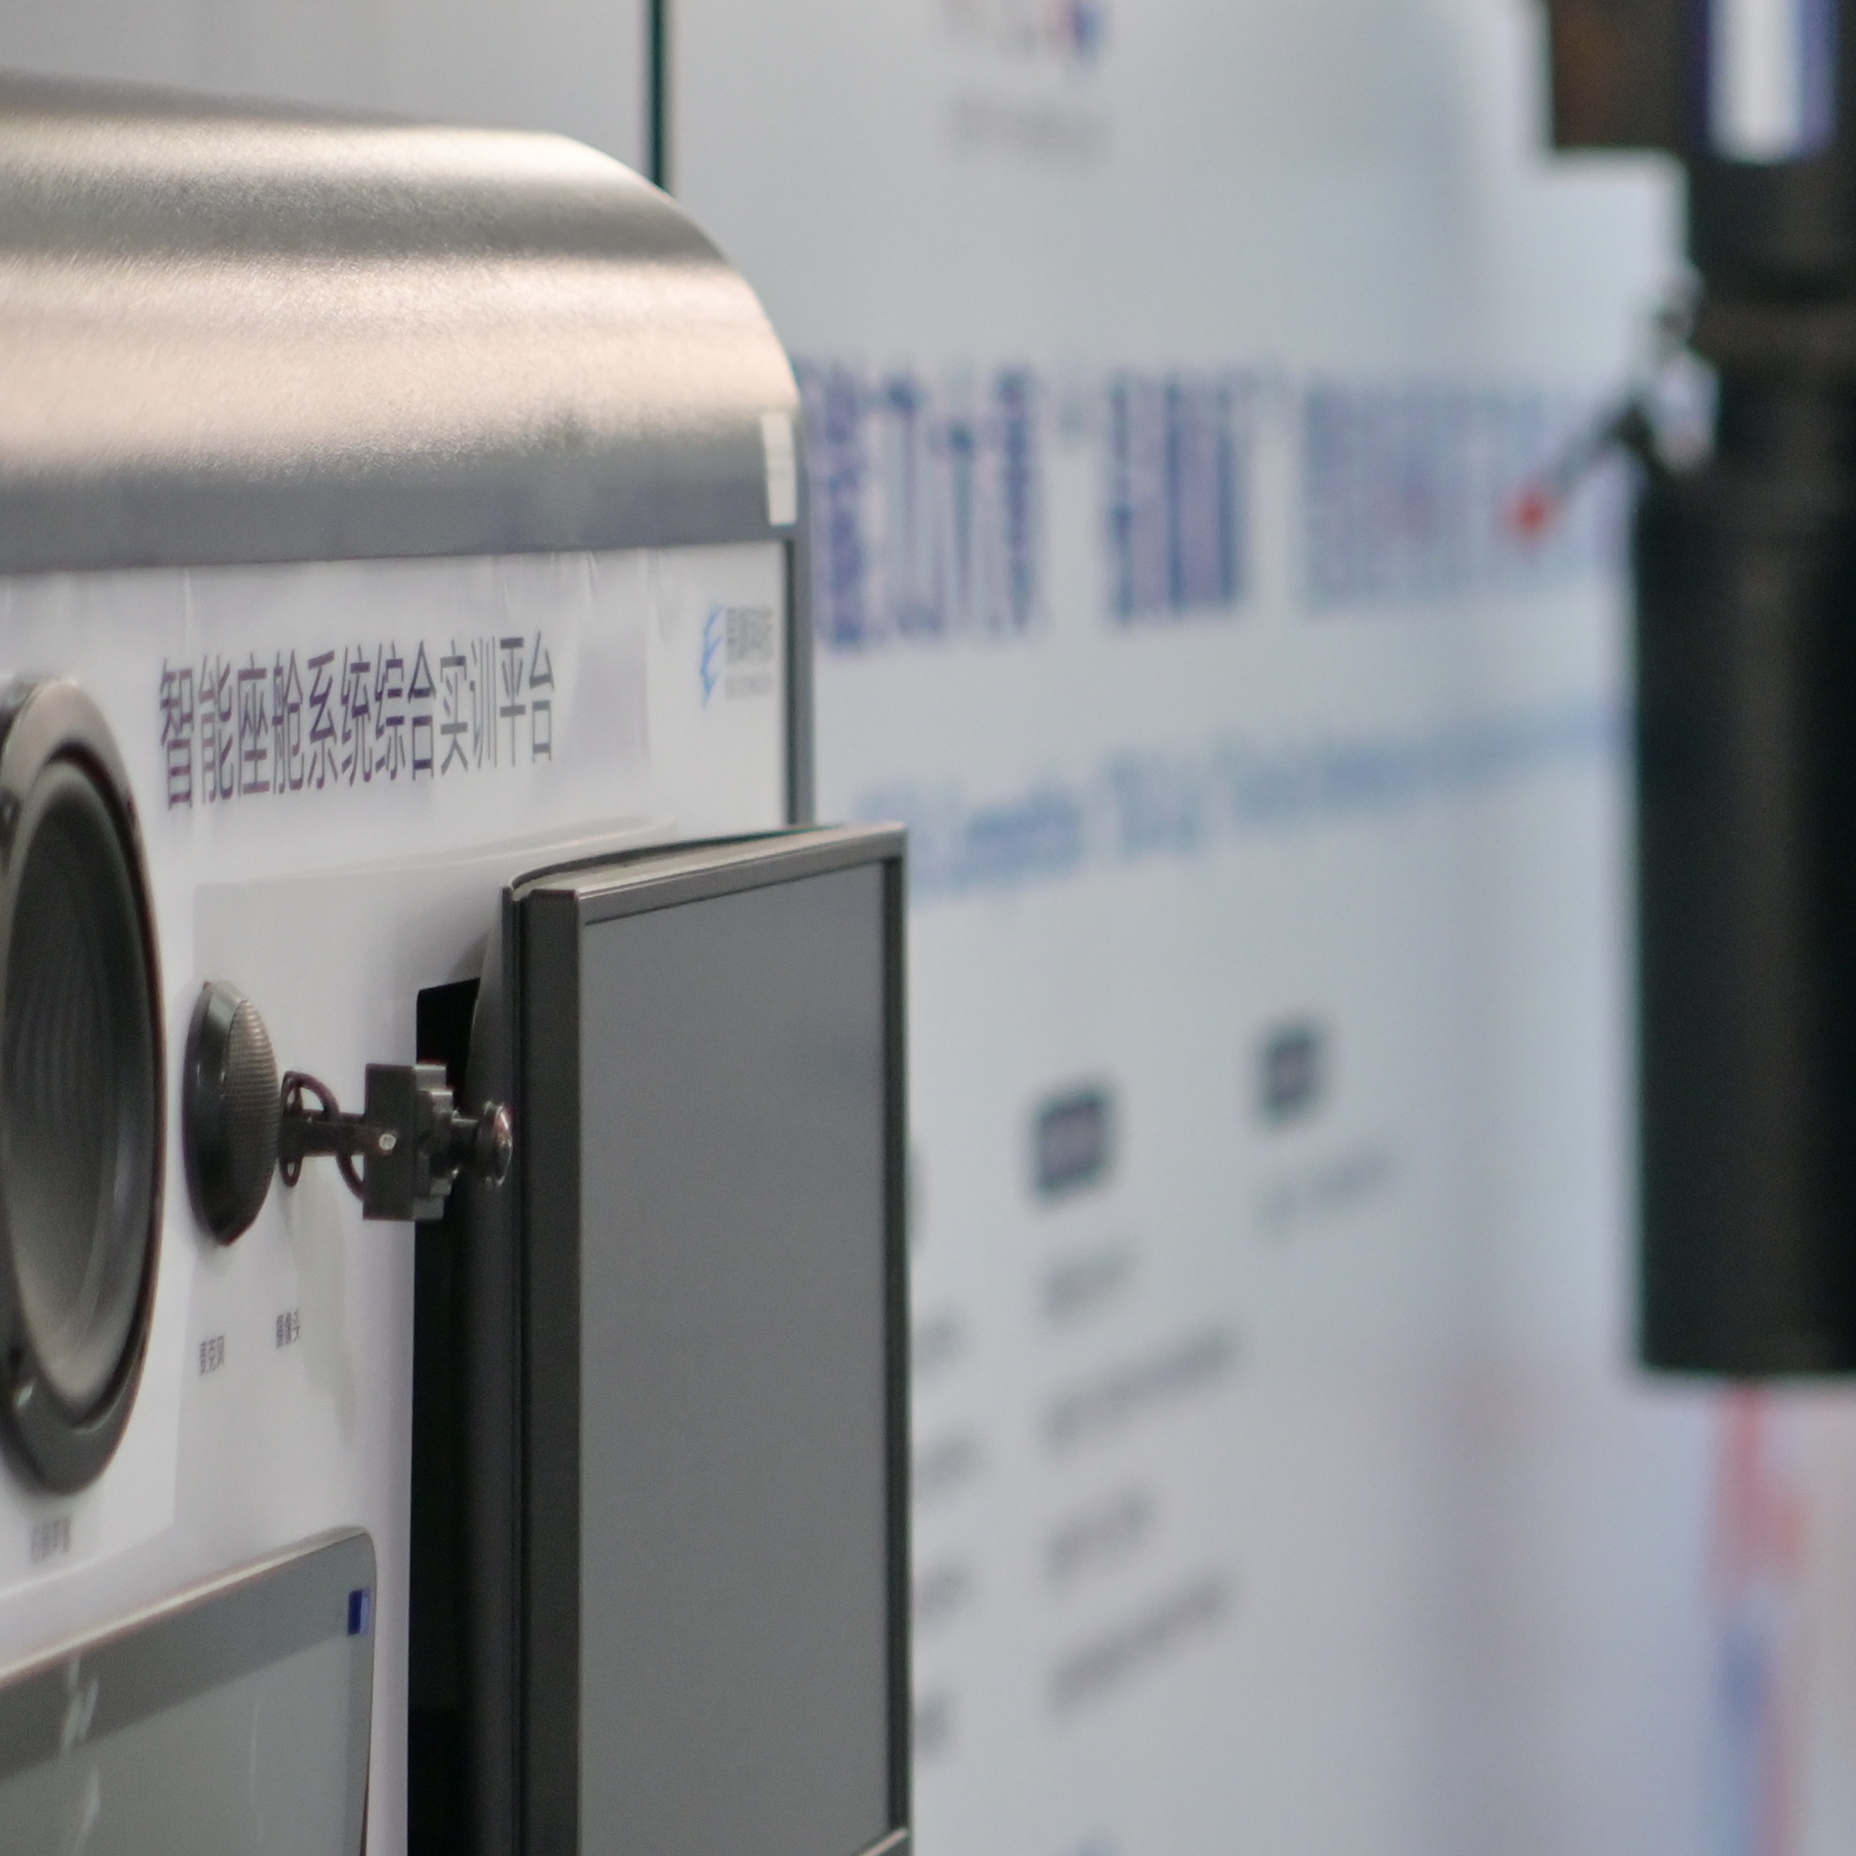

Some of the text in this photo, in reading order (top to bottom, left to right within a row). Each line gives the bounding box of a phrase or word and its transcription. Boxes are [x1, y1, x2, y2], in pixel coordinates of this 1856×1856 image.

[160, 631, 555, 811] 智能座舱系统综合实训平台
